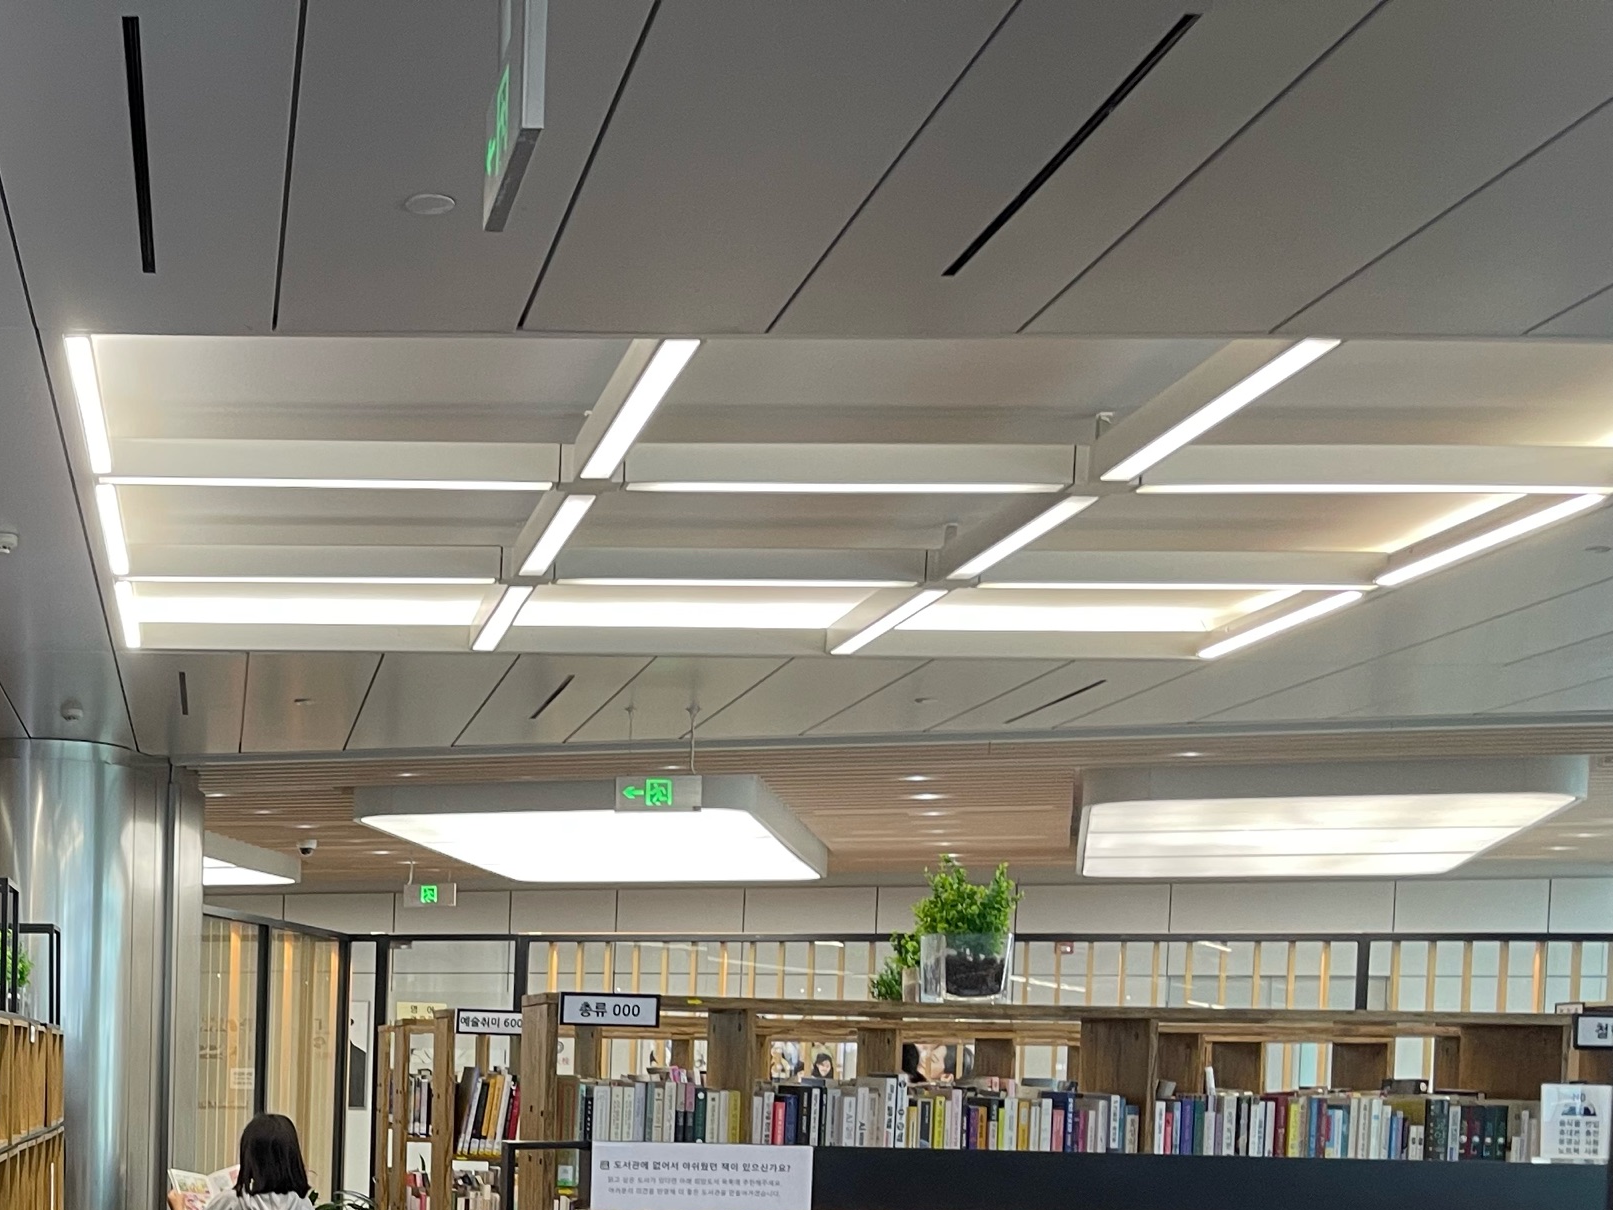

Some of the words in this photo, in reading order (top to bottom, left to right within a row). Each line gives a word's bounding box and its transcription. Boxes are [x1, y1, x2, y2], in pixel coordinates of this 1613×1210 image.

[579, 1001, 608, 1018] 총류
[612, 1003, 641, 1017] 000
[461, 1016, 500, 1028] 예술취미
[1595, 1022, 1613, 1039] 철
[614, 1160, 649, 1170] 도서관에
[653, 1161, 679, 1170] 없어서
